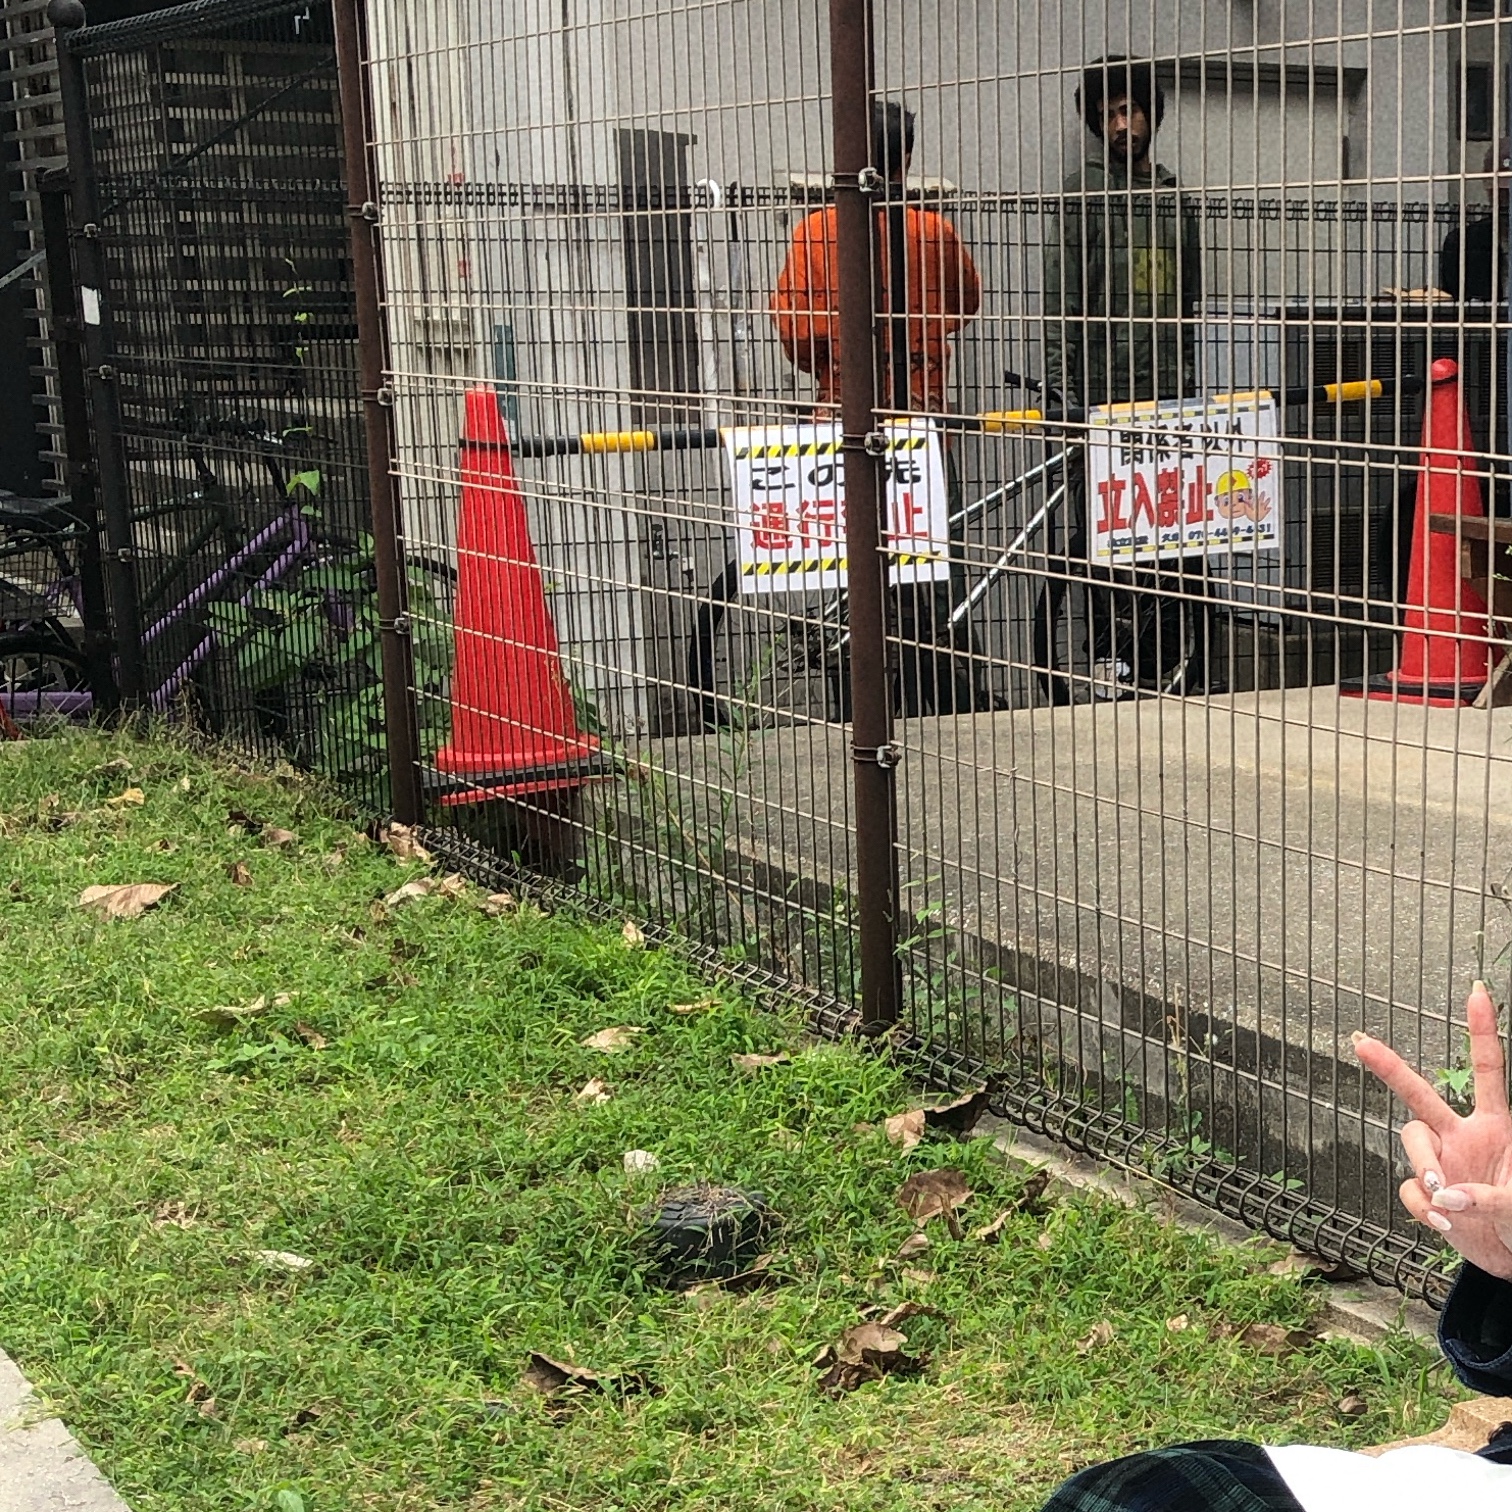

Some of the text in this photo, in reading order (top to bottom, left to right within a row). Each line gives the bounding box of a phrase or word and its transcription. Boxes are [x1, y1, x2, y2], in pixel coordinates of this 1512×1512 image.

[750, 492, 929, 551] 通行止
[1097, 465, 1215, 534] 立入禁止
